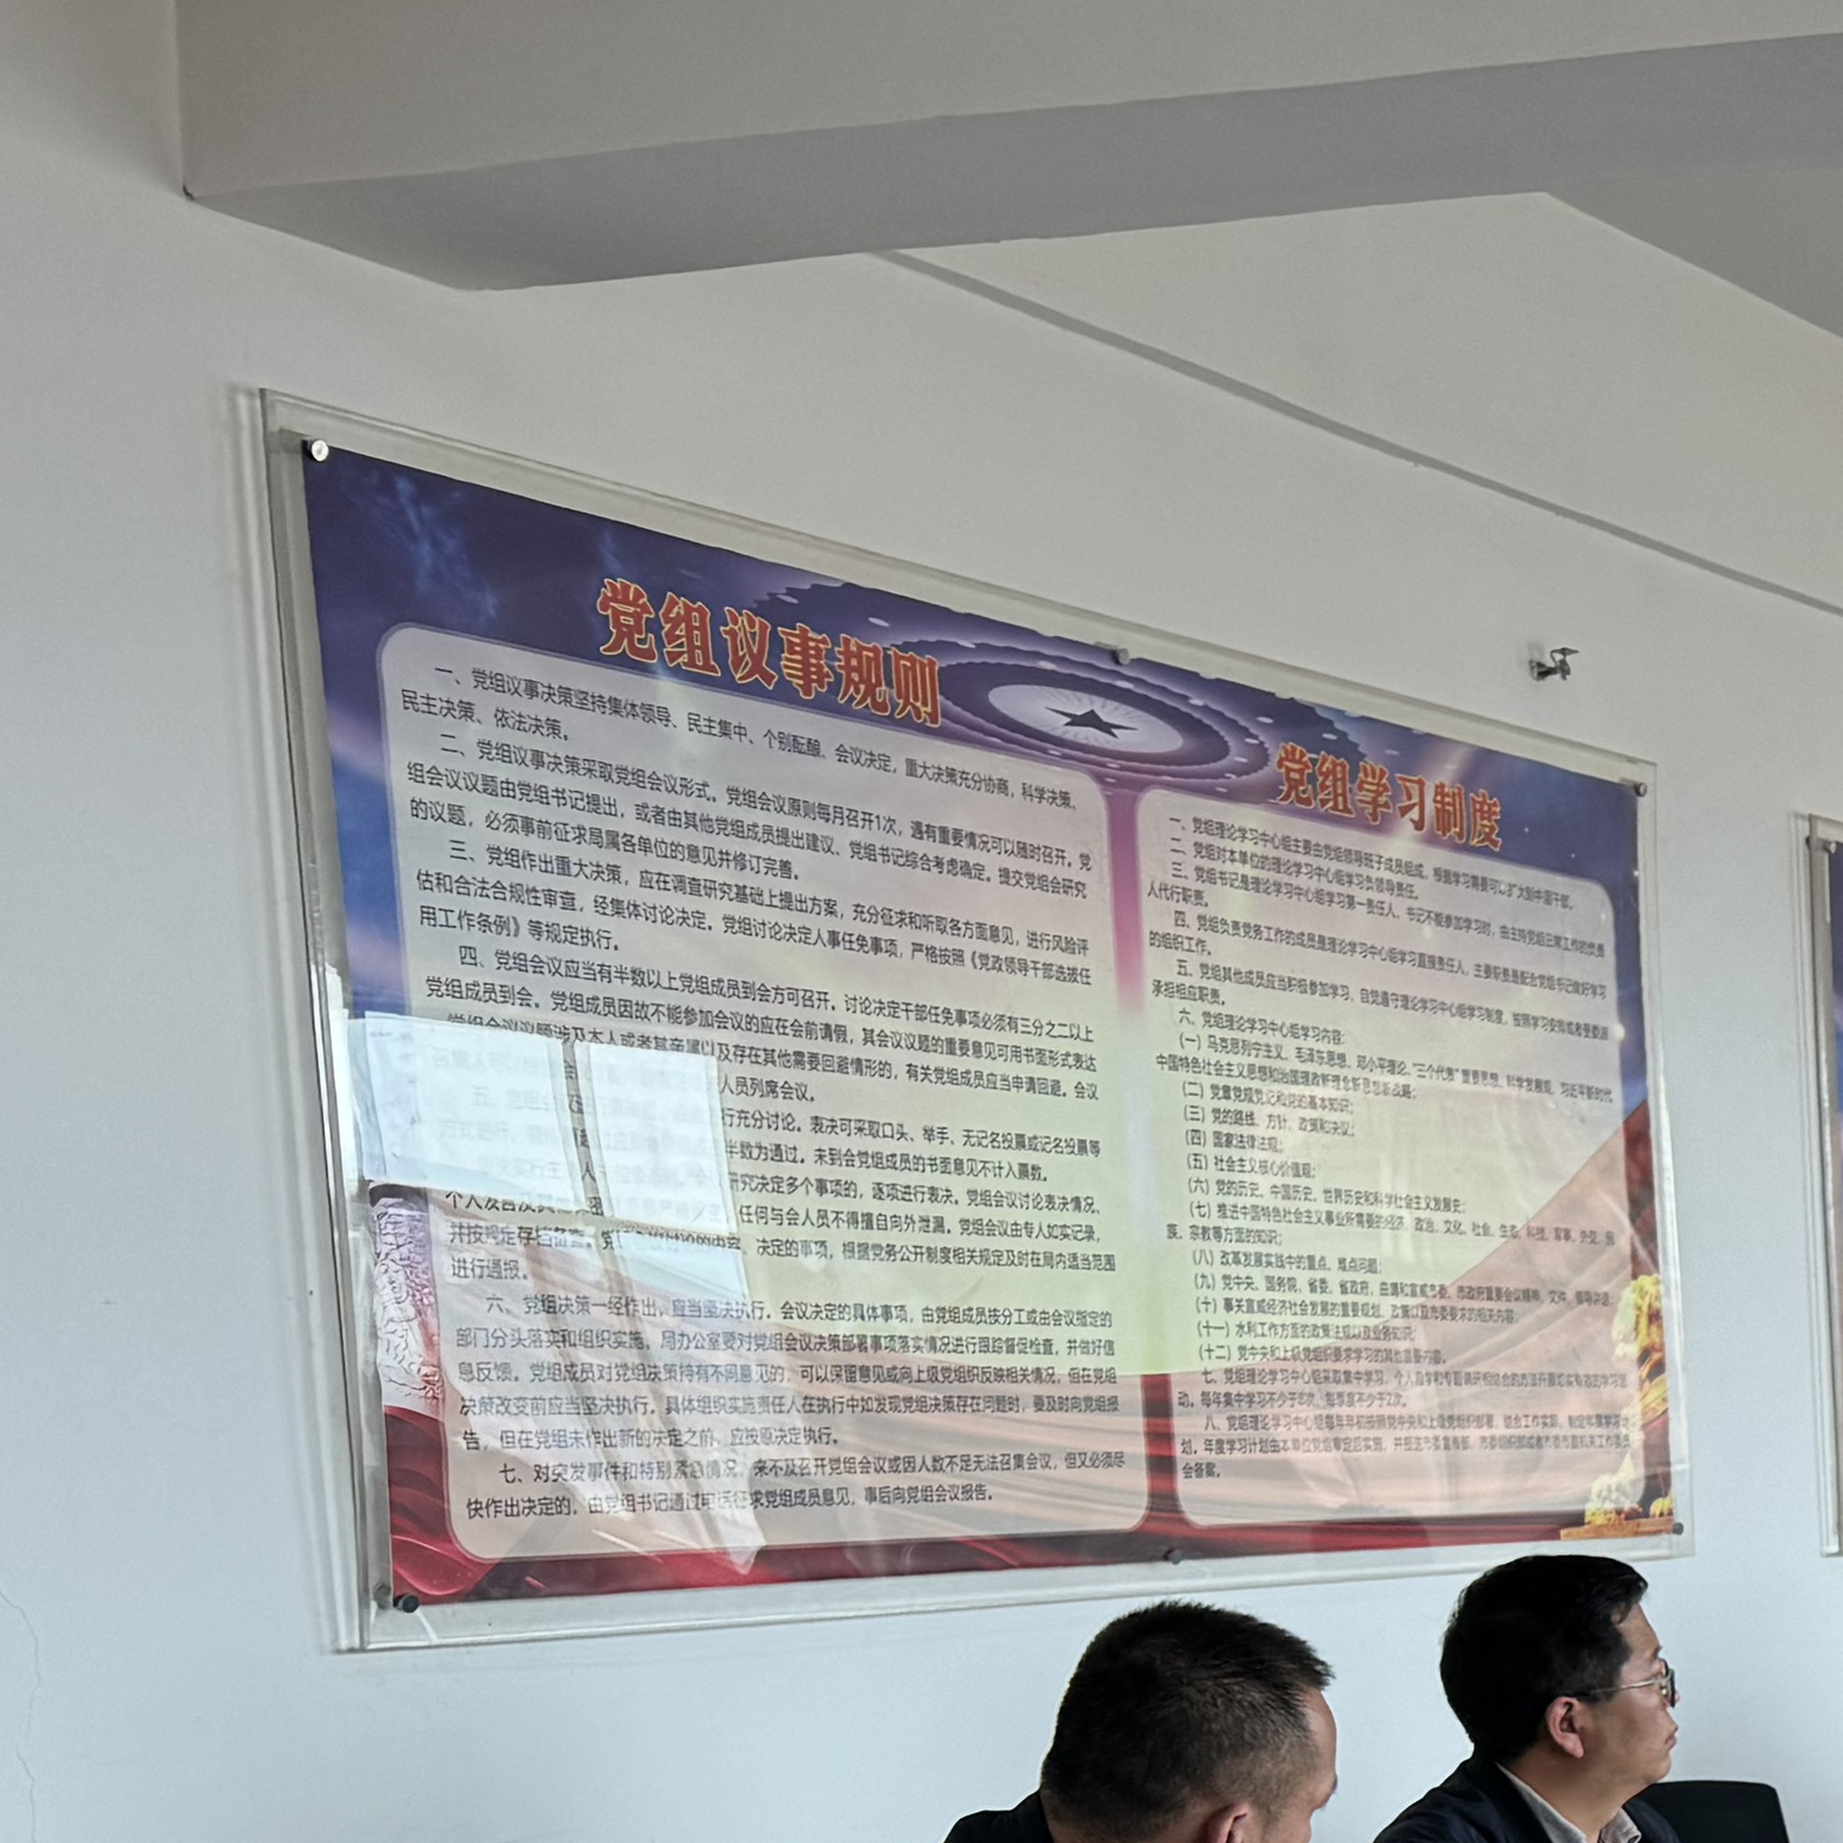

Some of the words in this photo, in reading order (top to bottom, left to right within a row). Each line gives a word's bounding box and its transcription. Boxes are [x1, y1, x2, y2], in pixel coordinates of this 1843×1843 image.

[595, 572, 944, 730] 党组议事规则
[401, 687, 570, 742] 民主决策、依法决策。
[1274, 739, 1504, 854] 党组学习制度
[419, 903, 620, 952] 用工作条例》等规定执行。
